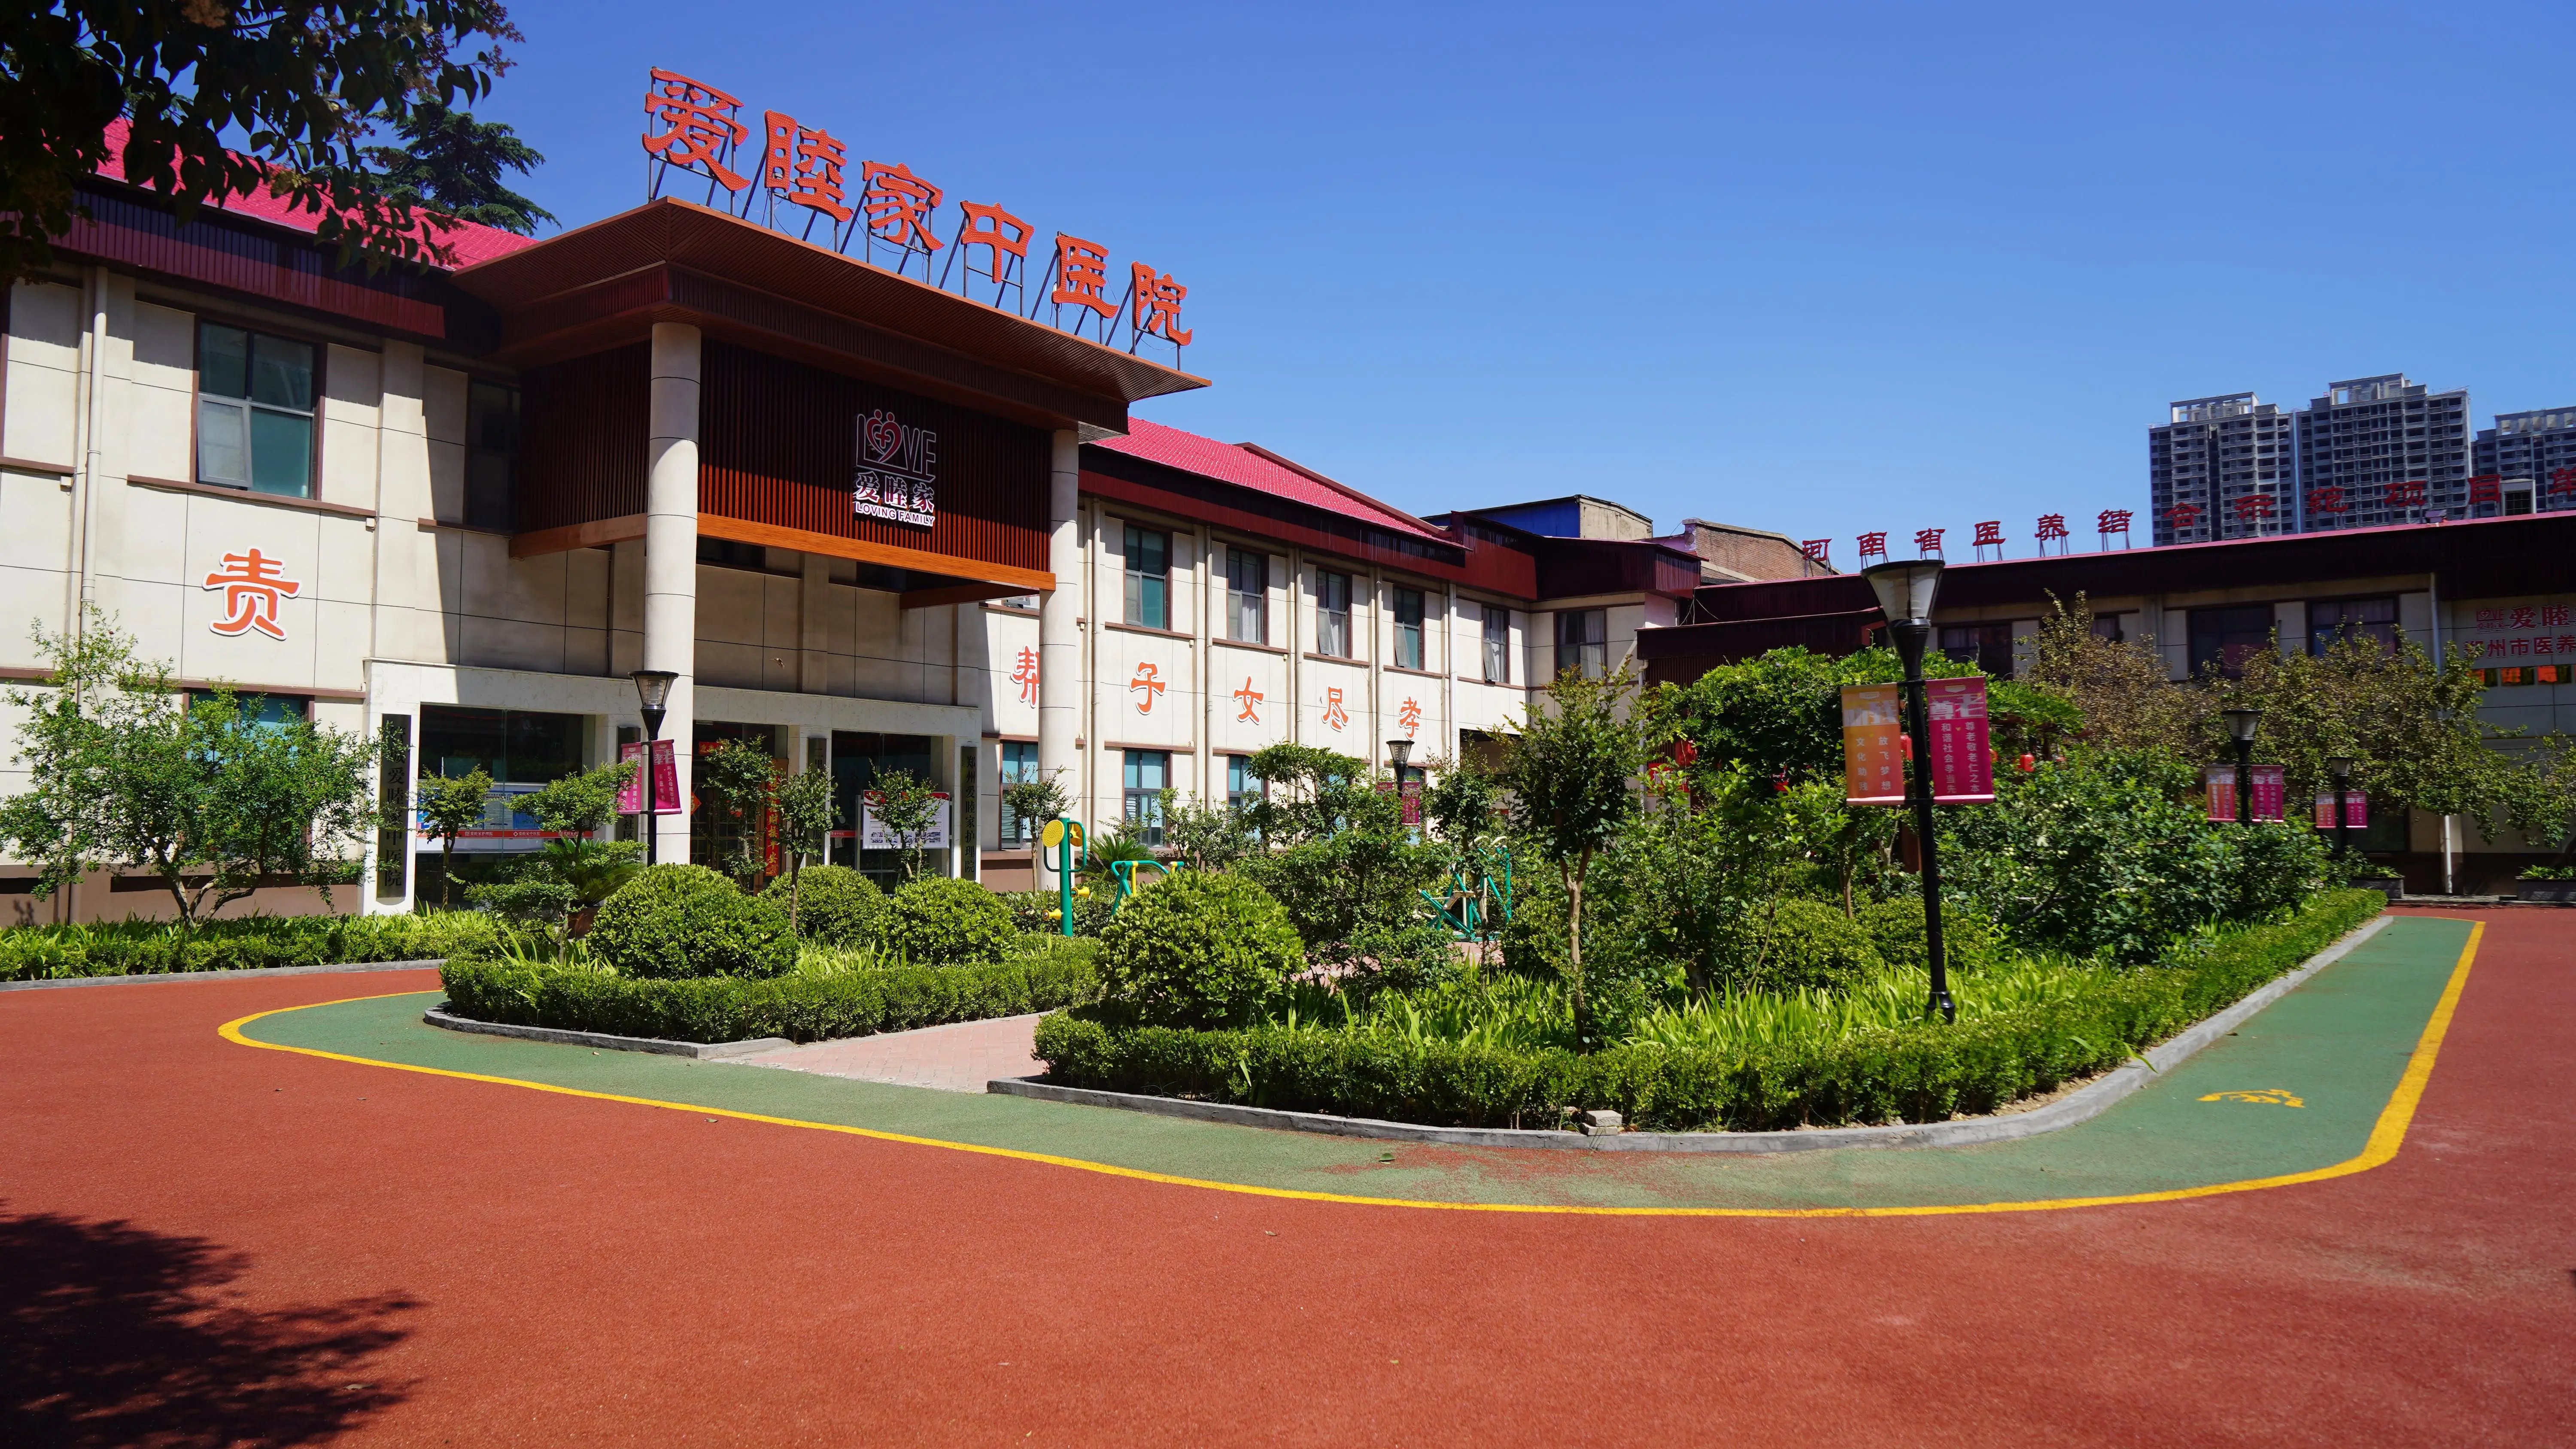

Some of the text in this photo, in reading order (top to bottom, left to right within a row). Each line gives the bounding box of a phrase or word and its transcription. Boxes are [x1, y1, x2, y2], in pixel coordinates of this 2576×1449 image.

[642, 66, 1193, 346] 爱睦家中医院
[854, 471, 935, 513] 爱睦家
[856, 502, 935, 527] LOVING FAMILY
[204, 546, 301, 640] 责
[2509, 603, 2576, 631] 爱睦
[1930, 694, 1983, 720] 尊老
[1856, 737, 1868, 791] 文化助残
[1878, 737, 1892, 790] 放飞梦想
[1941, 723, 1957, 794] 和谐社会孝当先
[1965, 721, 1980, 792] 尊老敬老仁之本
[383, 727, 406, 887] 爱睦中医院
[965, 756, 975, 873] 郑州爱睦家护理院
